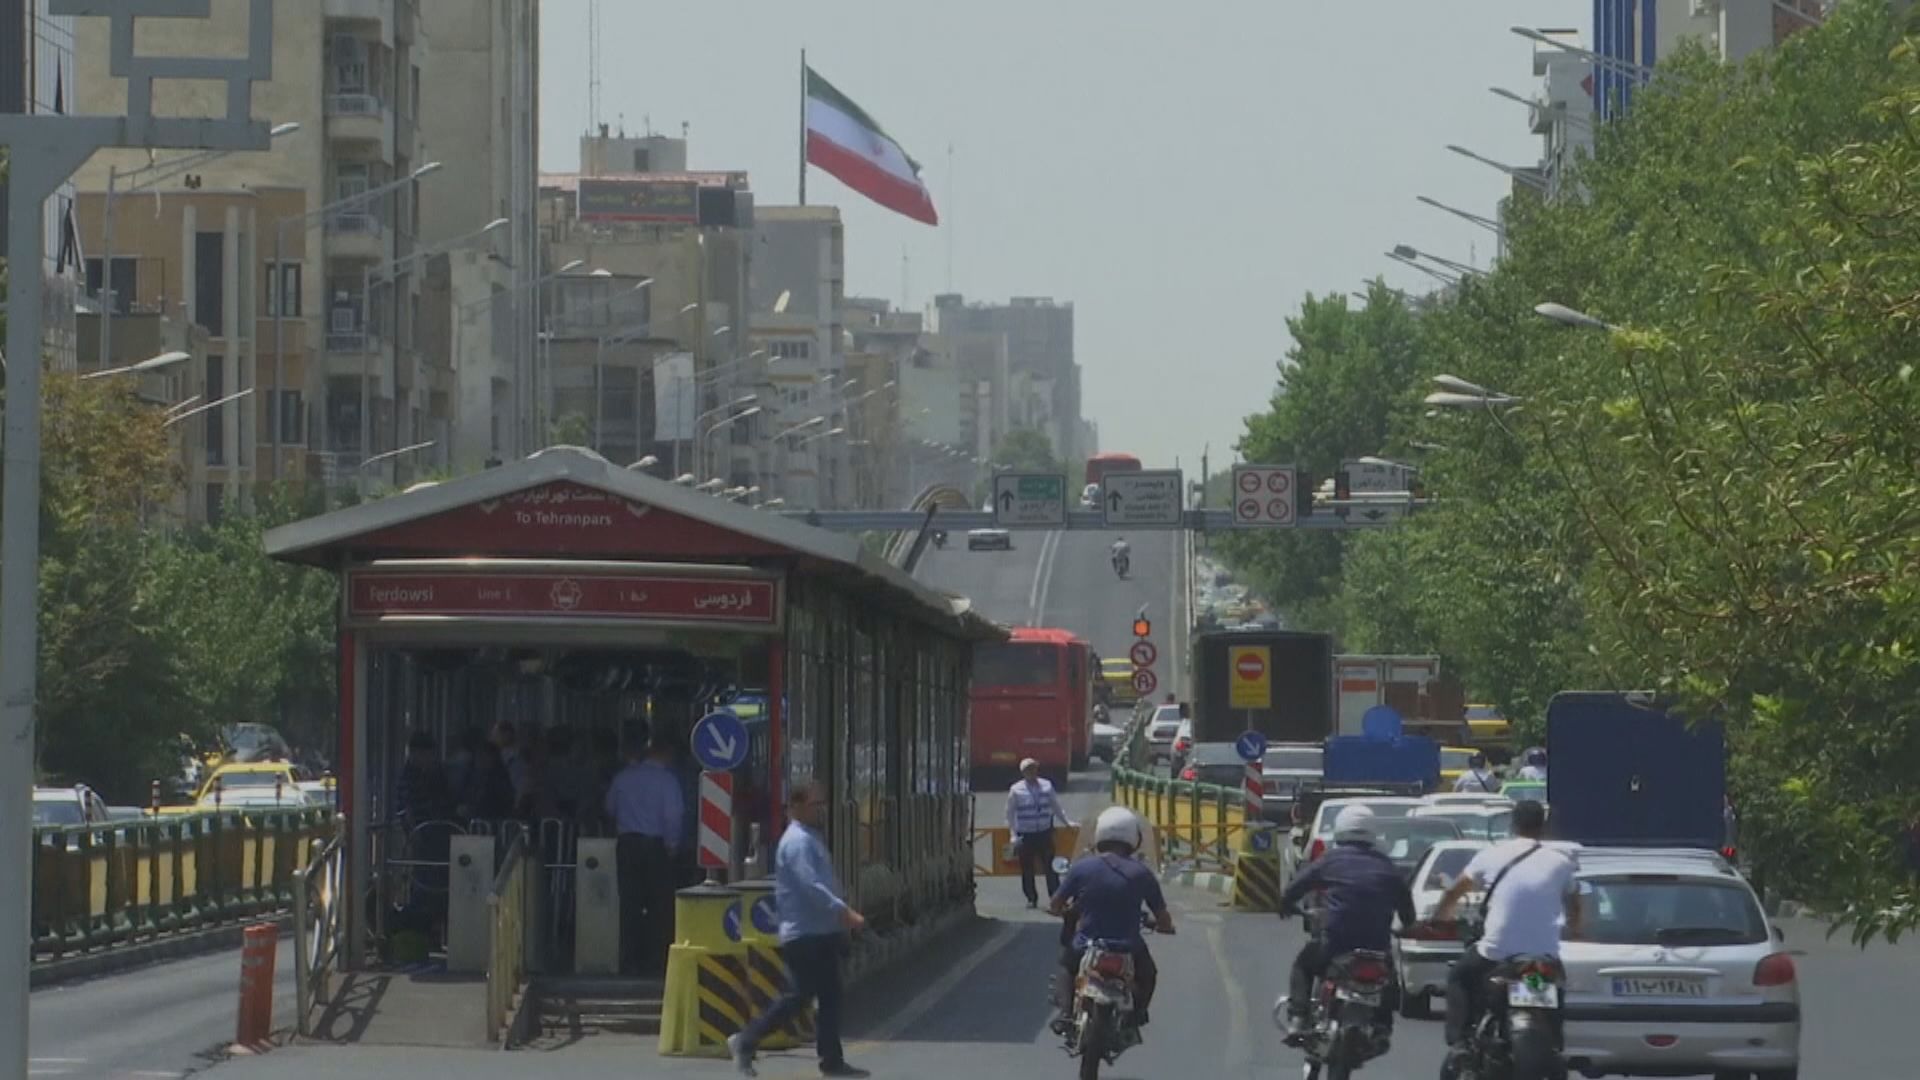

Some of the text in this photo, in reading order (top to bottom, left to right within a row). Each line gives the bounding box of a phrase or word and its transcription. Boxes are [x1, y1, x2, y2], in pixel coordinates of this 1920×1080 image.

[515, 511, 613, 527] To Tehranpars
[369, 585, 434, 602] Ferdowsi
[478, 587, 500, 600] Line
[694, 589, 752, 609] فردوسی
